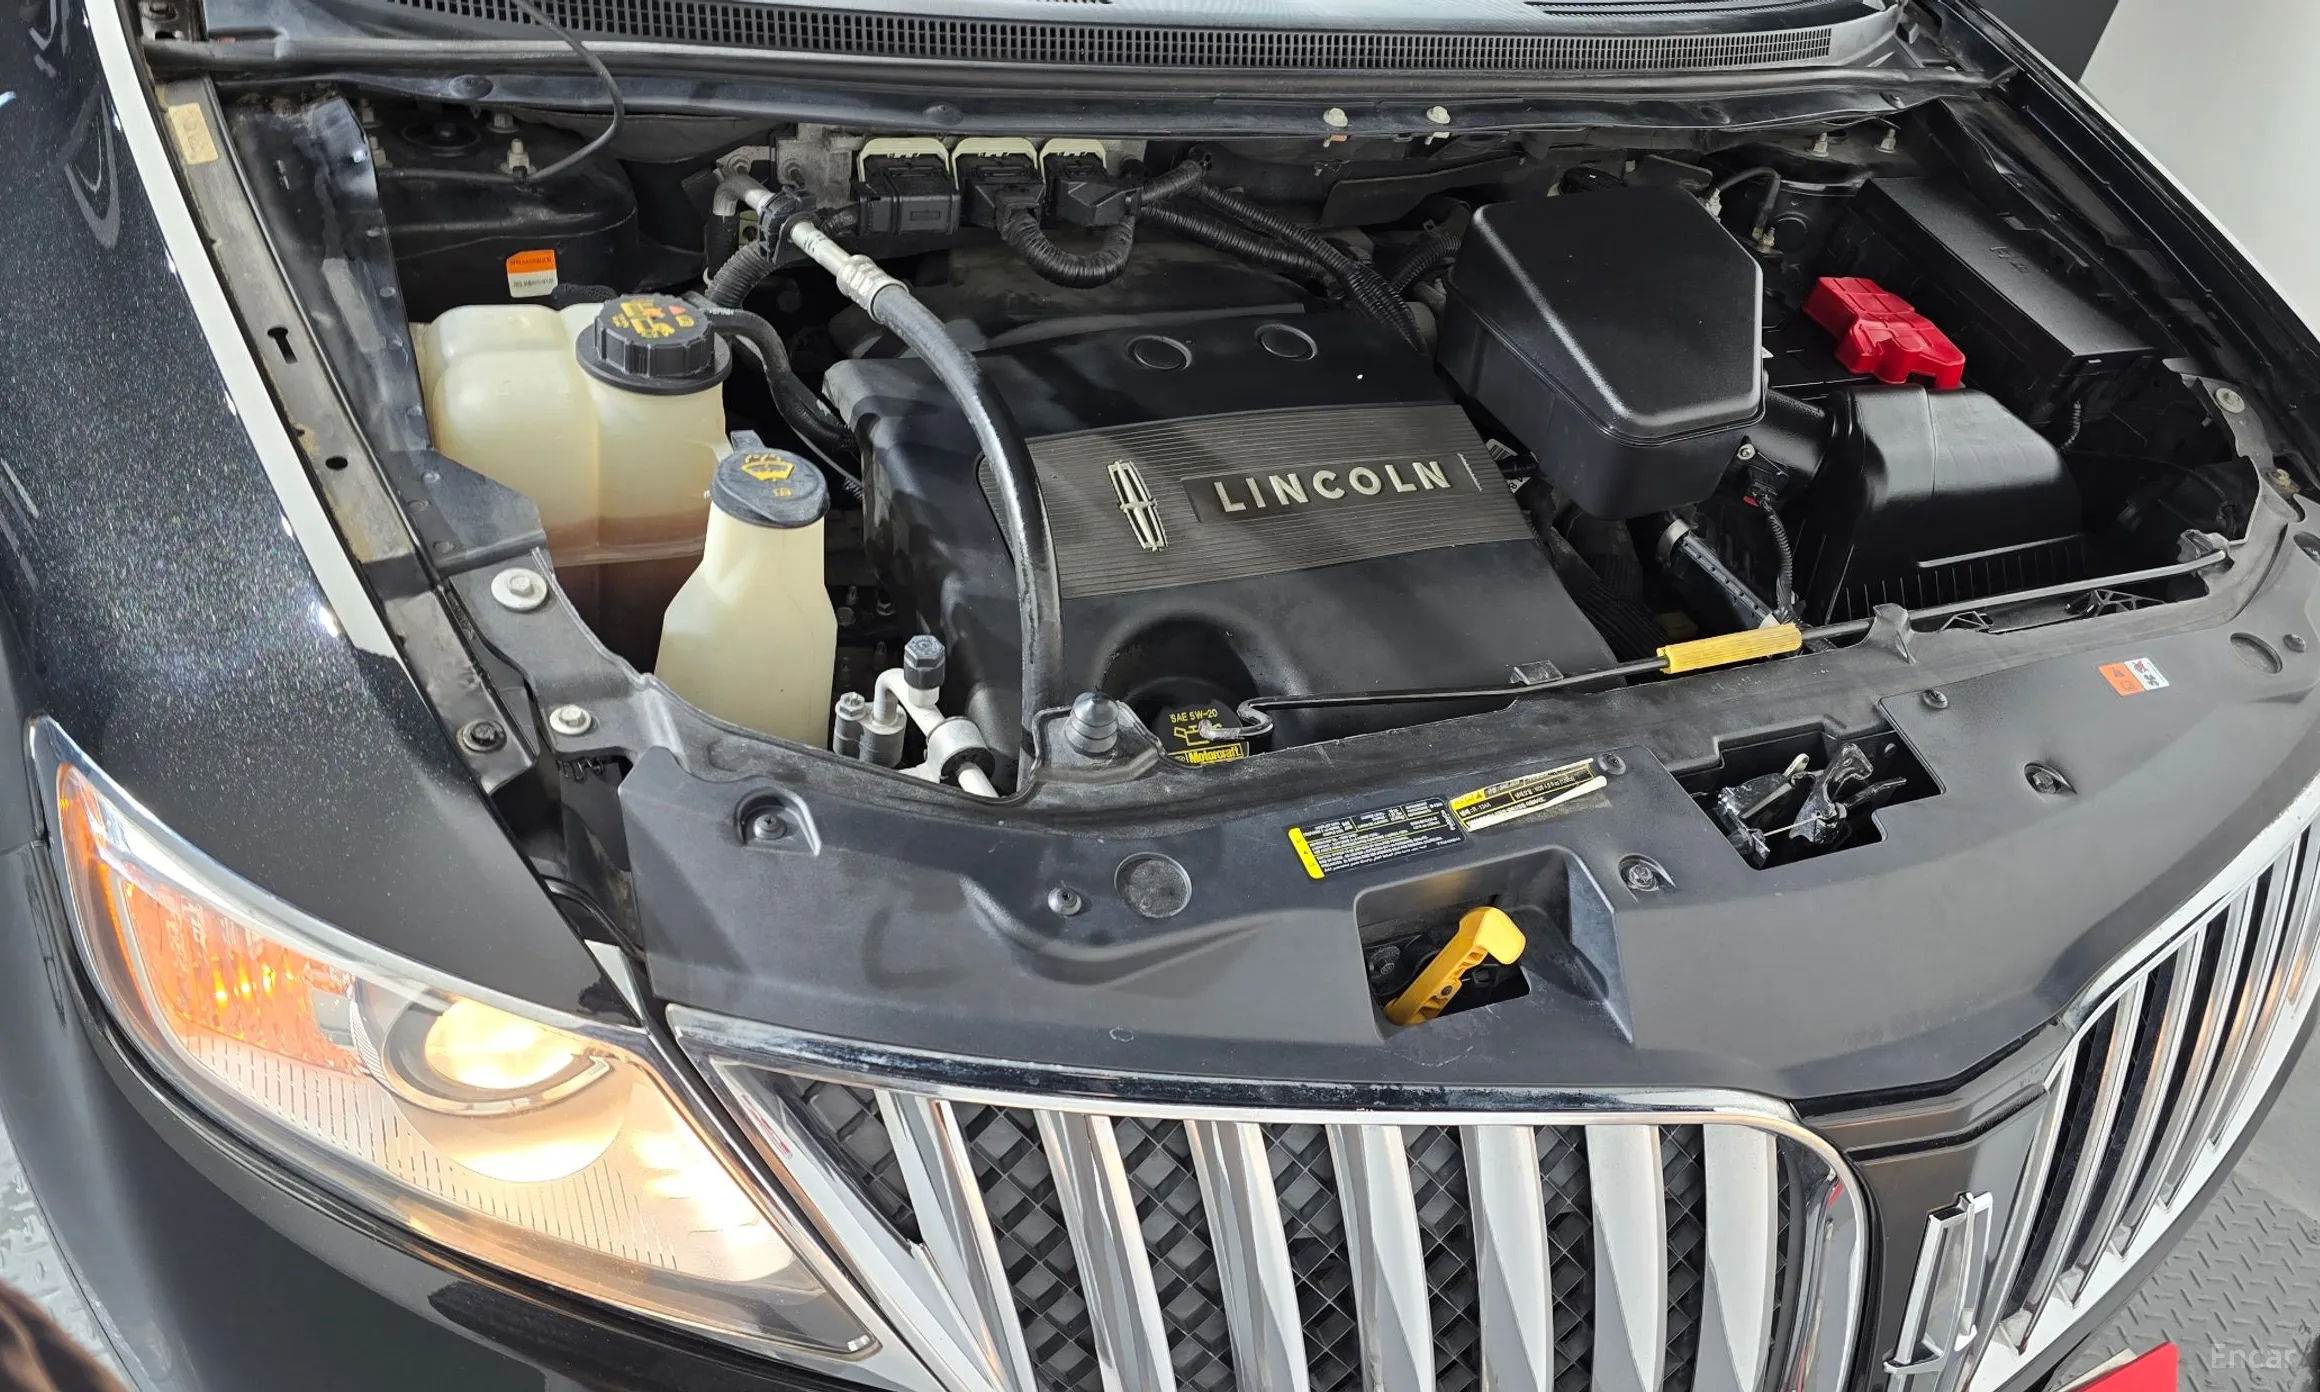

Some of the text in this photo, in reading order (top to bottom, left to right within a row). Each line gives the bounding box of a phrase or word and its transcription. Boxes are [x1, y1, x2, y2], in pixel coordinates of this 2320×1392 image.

[1214, 461, 1451, 513] LINCOLN
[1170, 708, 1218, 723] SAE 5W-20
[1187, 745, 1241, 763] Motorcraft
